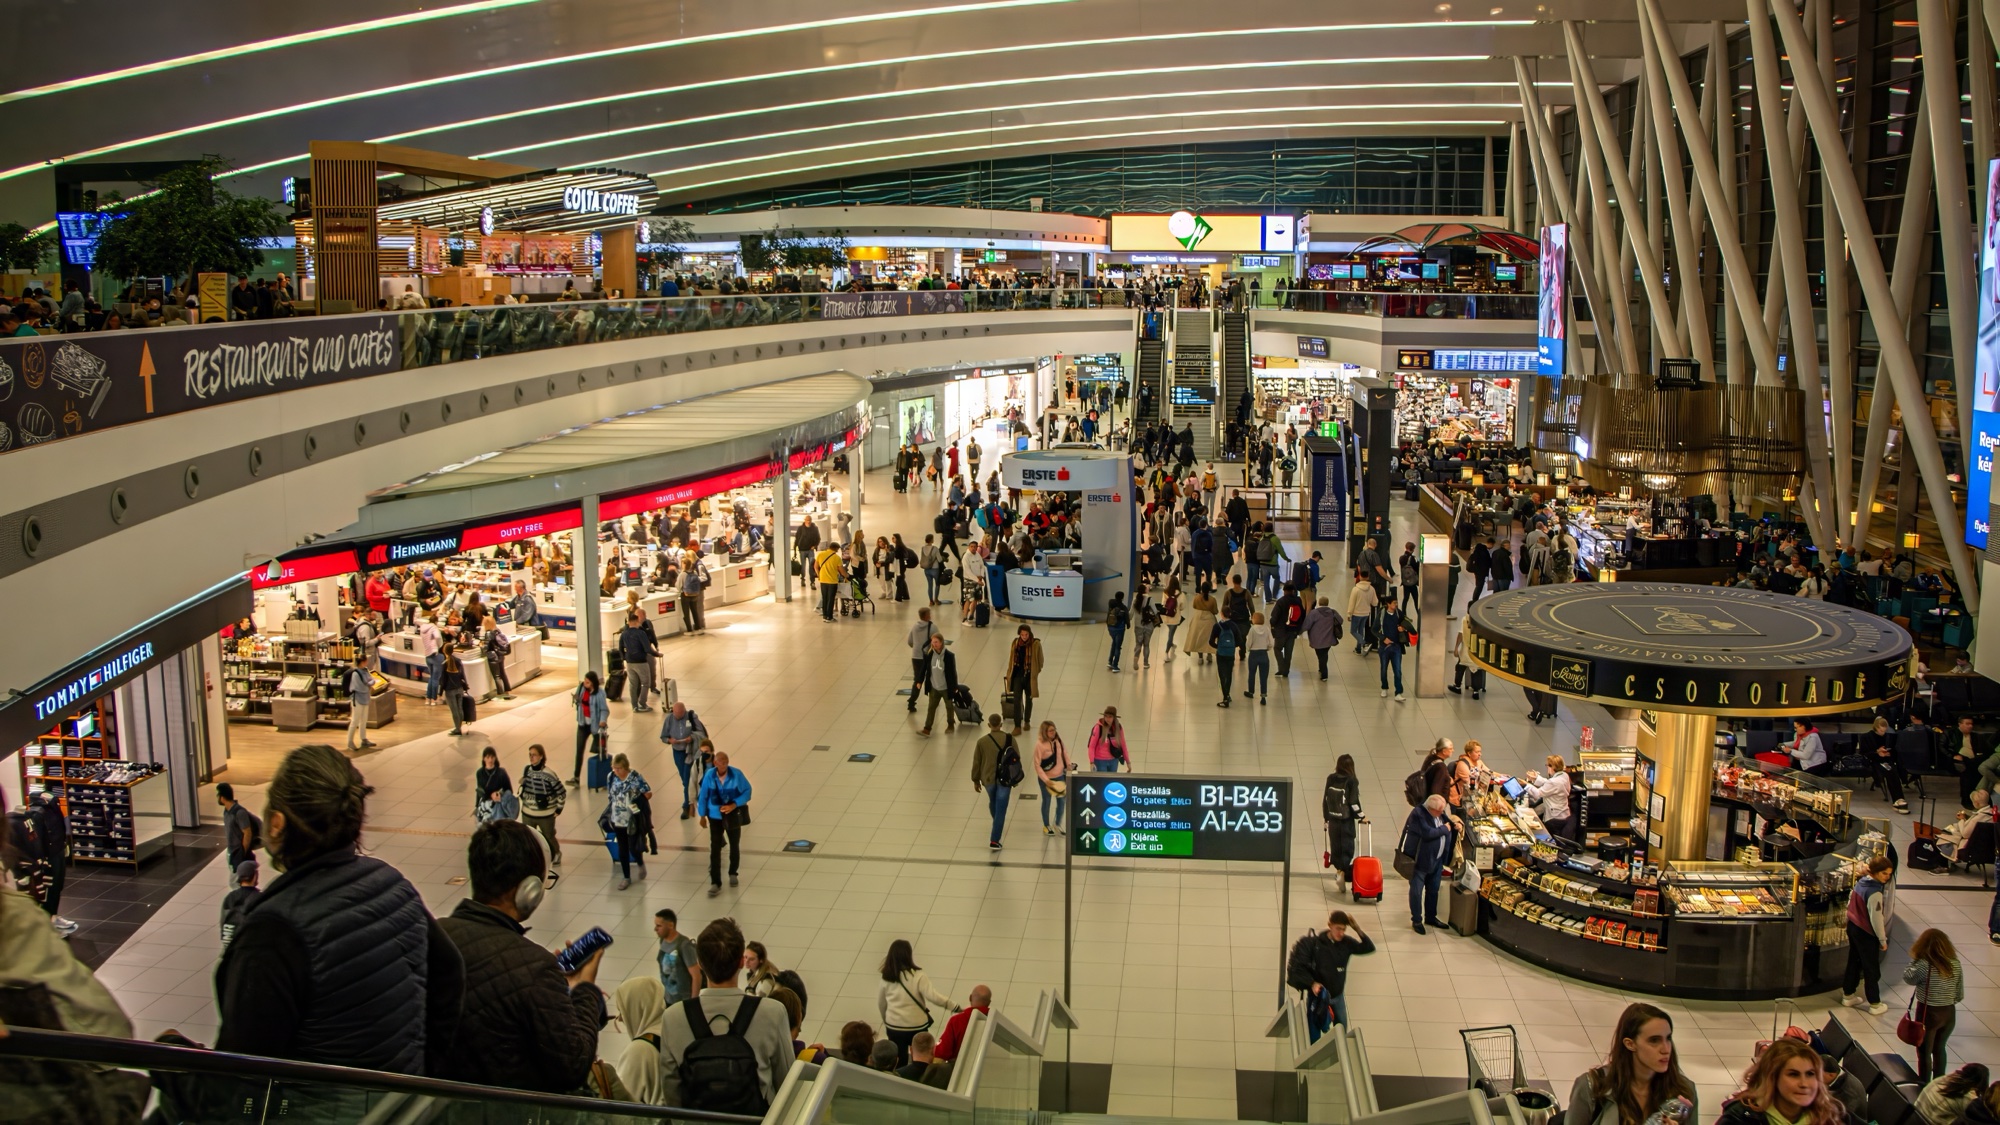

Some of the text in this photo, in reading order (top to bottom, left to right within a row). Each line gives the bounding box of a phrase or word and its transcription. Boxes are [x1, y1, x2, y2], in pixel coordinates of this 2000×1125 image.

[565, 187, 639, 215] COSTA COFFEE
[1022, 469, 1056, 481] ERSTE
[655, 489, 694, 505] TRAVEL VALUE
[1087, 494, 1112, 503] ERSTE
[500, 522, 544, 539] DUTY FREE
[392, 537, 457, 559] HEINEMANN
[257, 568, 295, 582] VUE
[1021, 585, 1052, 598] ERSTE
[35, 641, 154, 720] TOMMY HILFIGER
[1624, 671, 1867, 705] CSOKOLÁDÉ
[1131, 785, 1171, 796] Beszállás
[1200, 784, 1279, 808] B1-B44
[1131, 795, 1167, 806] To gates
[1131, 810, 1171, 820] Beszállás
[1199, 809, 1283, 833] A1-A33
[1131, 820, 1167, 829] To gates
[1131, 832, 1158, 842] Kijárat
[1131, 842, 1147, 851] Exit
